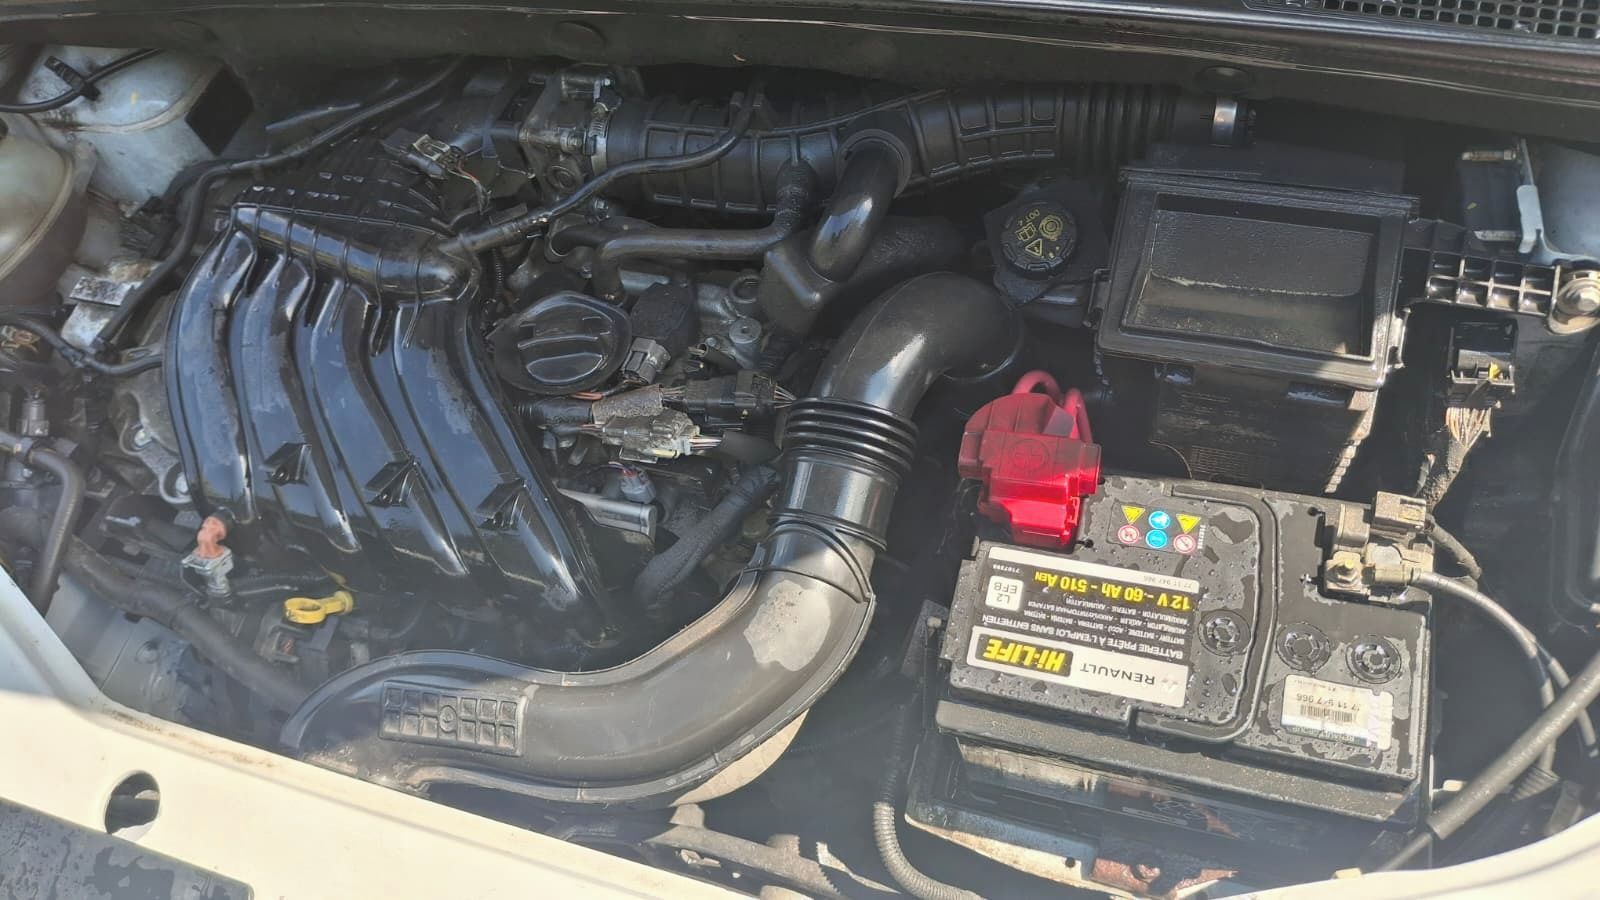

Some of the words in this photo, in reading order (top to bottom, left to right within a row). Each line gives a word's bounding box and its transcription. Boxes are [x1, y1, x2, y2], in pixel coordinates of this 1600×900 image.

[992, 581, 1017, 593] EFB
[1059, 575, 1087, 592] 510
[1100, 582, 1122, 598] Ah
[995, 592, 1010, 604] L2
[1123, 586, 1143, 602] 60
[1156, 592, 1169, 607] V
[1170, 594, 1191, 610] 12
[981, 613, 1029, 629] ENTRETIEN
[1029, 622, 1054, 634] SANS
[1055, 627, 1097, 643] L'EMPLOI
[1097, 636, 1106, 646] À
[1158, 634, 1184, 644] BATTERY
[1105, 637, 1137, 651] PRÊTE
[1137, 643, 1183, 659] BATTERIE
[1079, 662, 1155, 684] RENAULT
